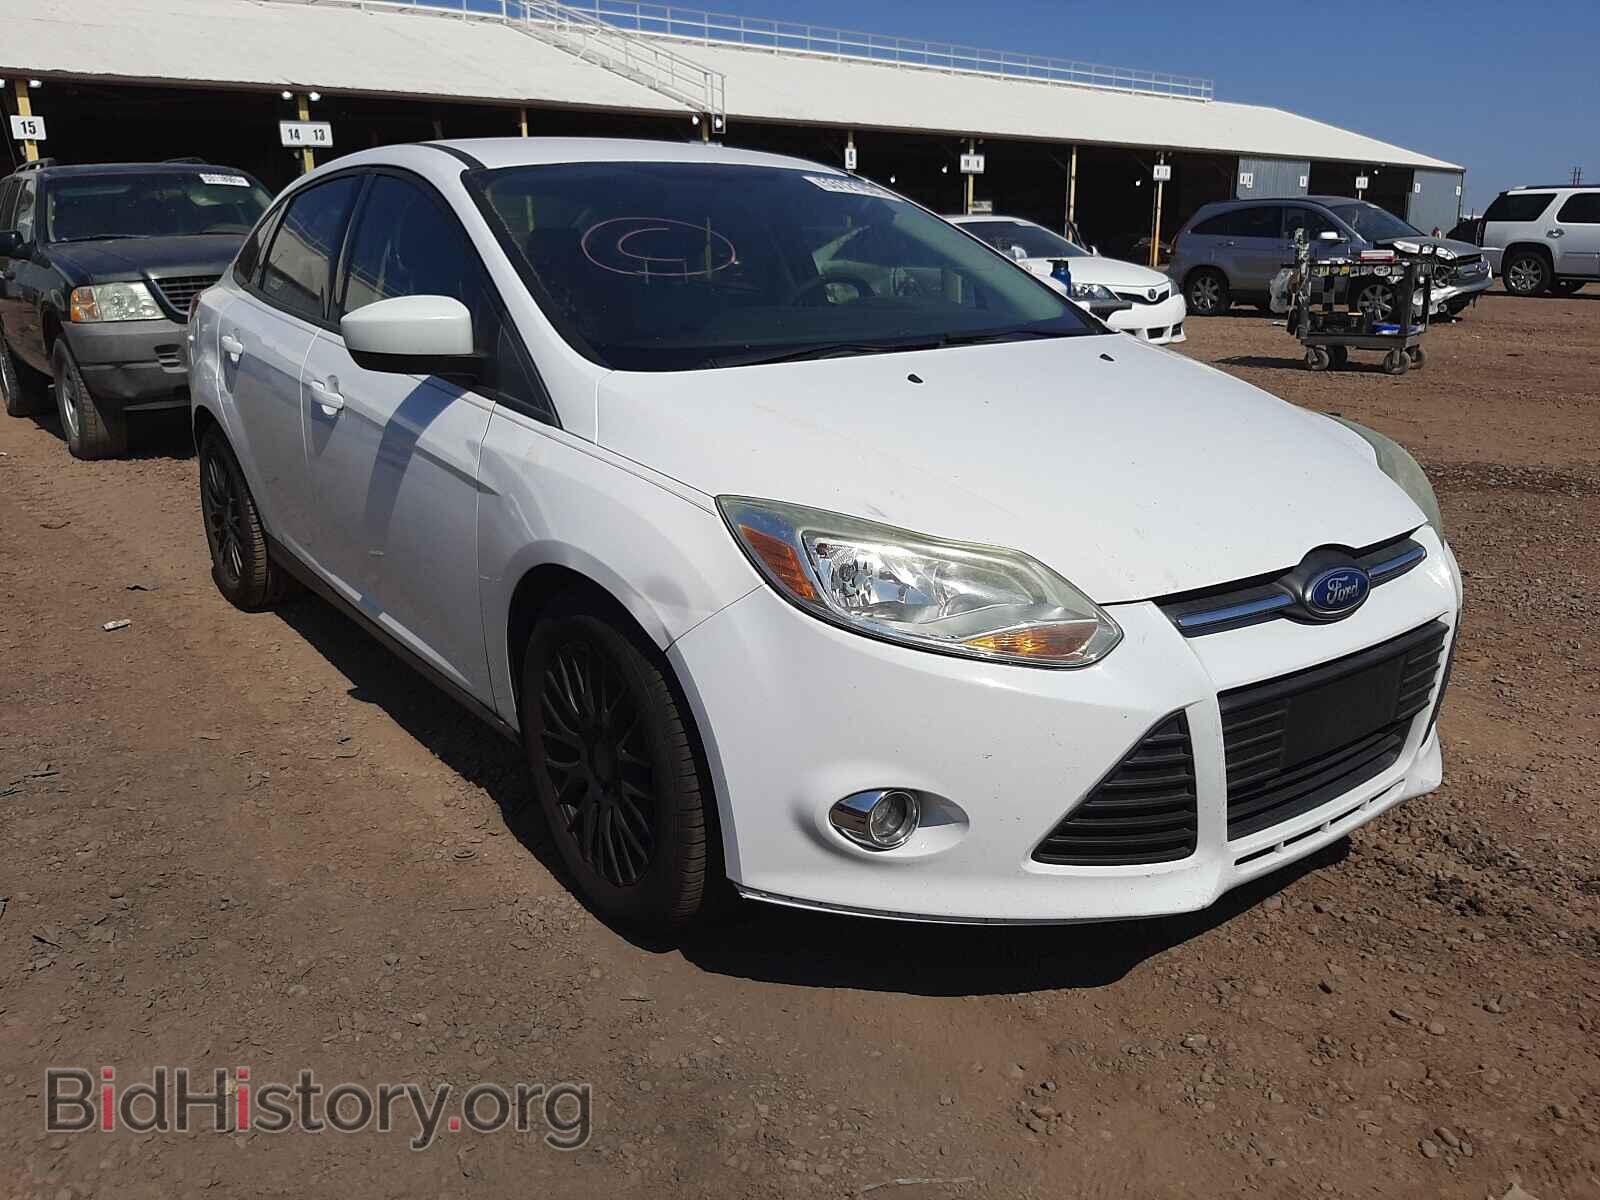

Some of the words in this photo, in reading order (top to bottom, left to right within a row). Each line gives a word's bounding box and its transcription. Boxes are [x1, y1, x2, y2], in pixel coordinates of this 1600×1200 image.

[20, 120, 37, 135] 15
[288, 128, 301, 141] 14
[312, 128, 326, 142] 13
[1326, 575, 1360, 605] Ford
